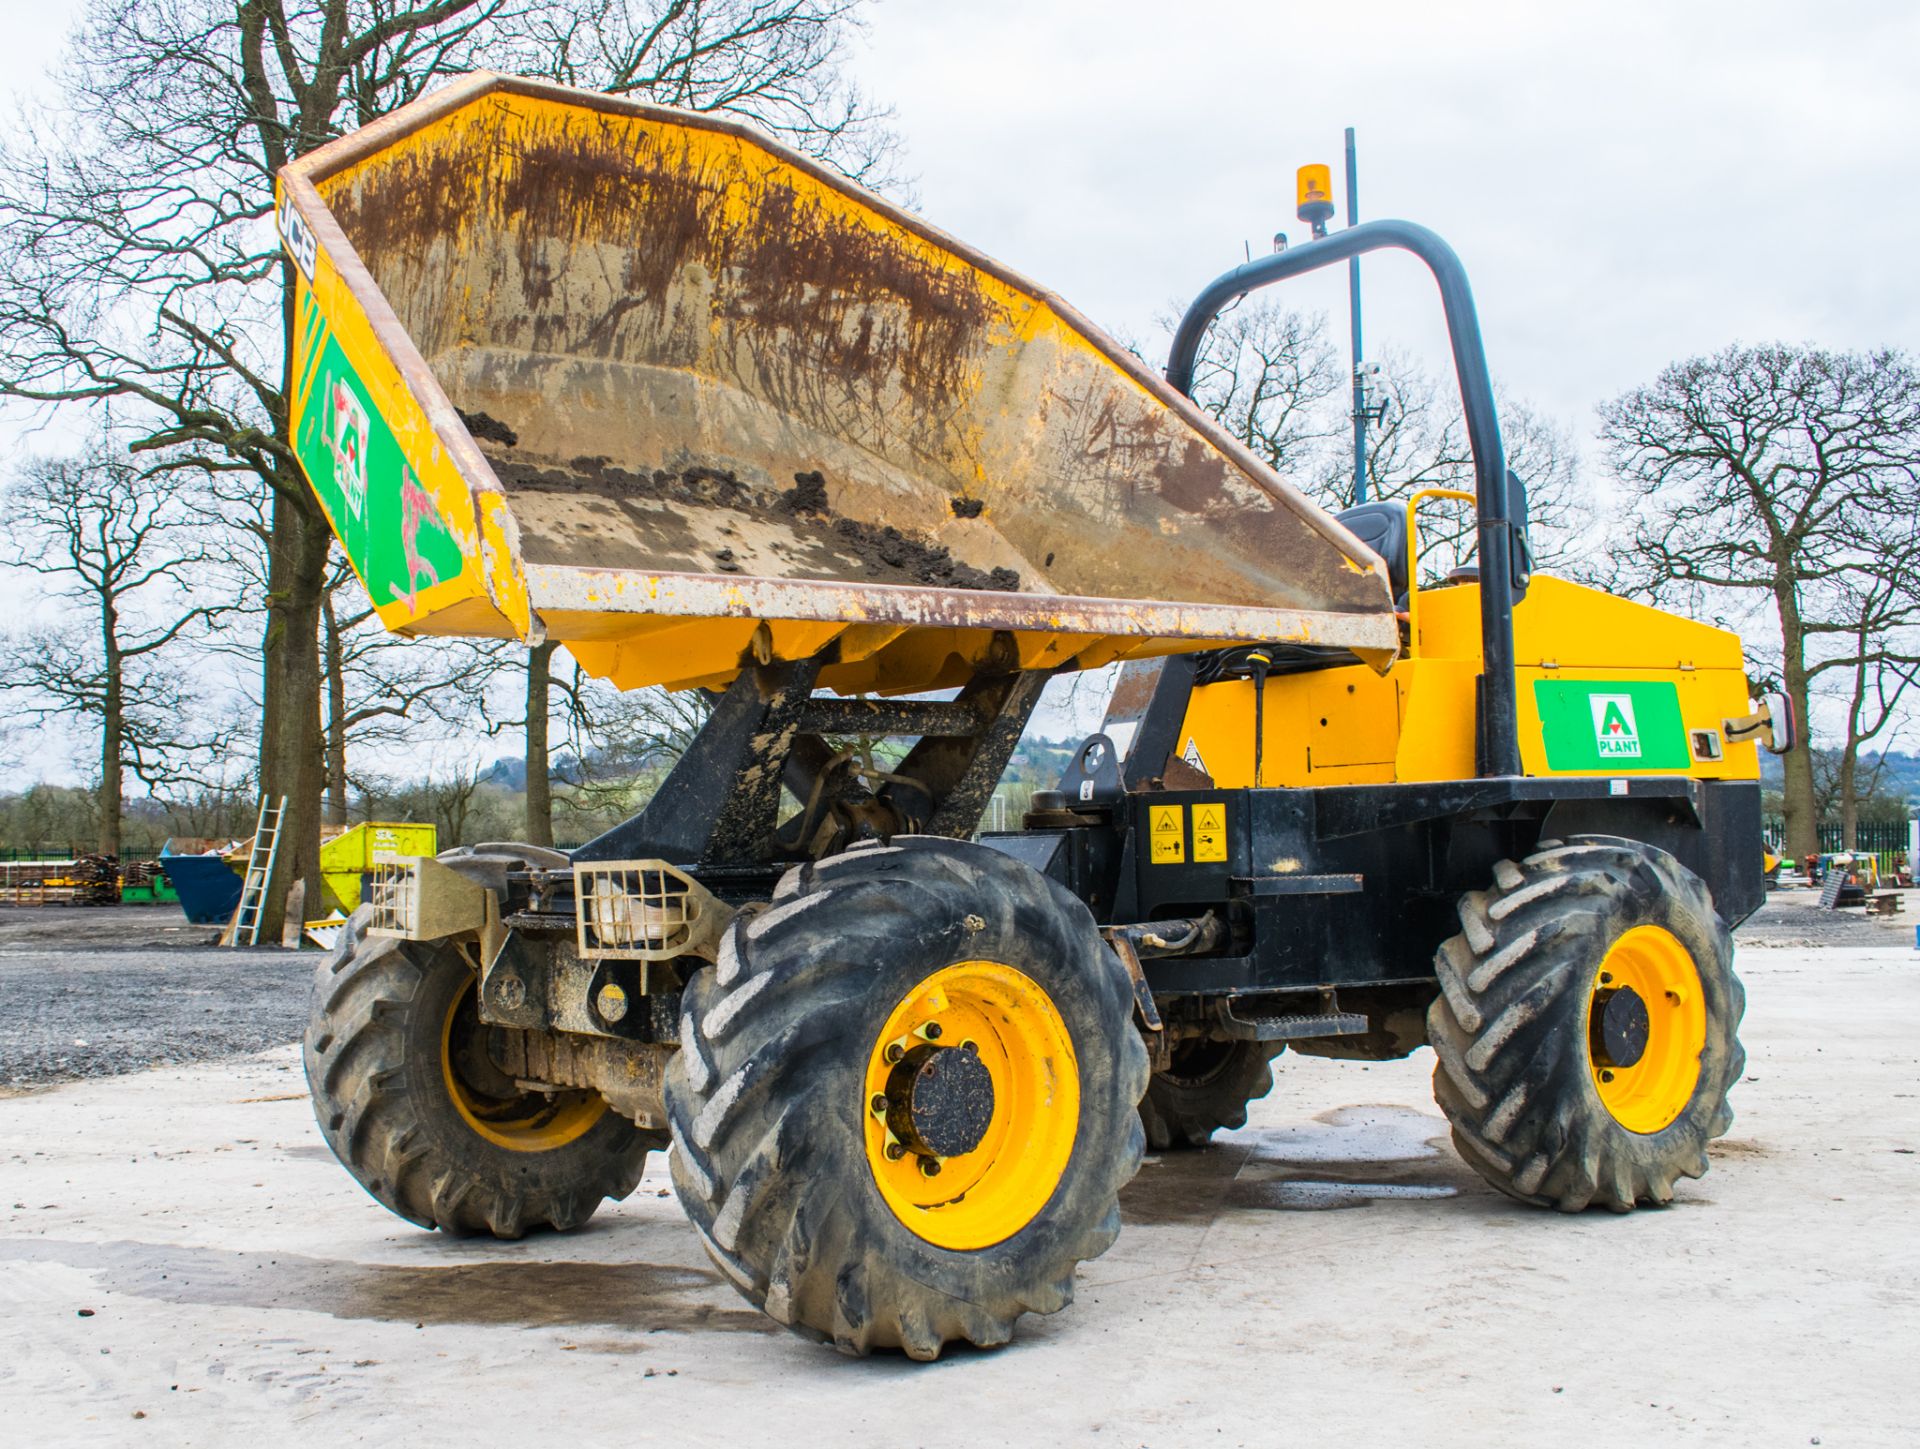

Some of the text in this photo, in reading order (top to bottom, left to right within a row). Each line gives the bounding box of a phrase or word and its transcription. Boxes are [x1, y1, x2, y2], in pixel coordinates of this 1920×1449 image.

[279, 196, 317, 281] JCB
[1601, 701, 1633, 736] A
[1600, 740, 1638, 753] PLANT
